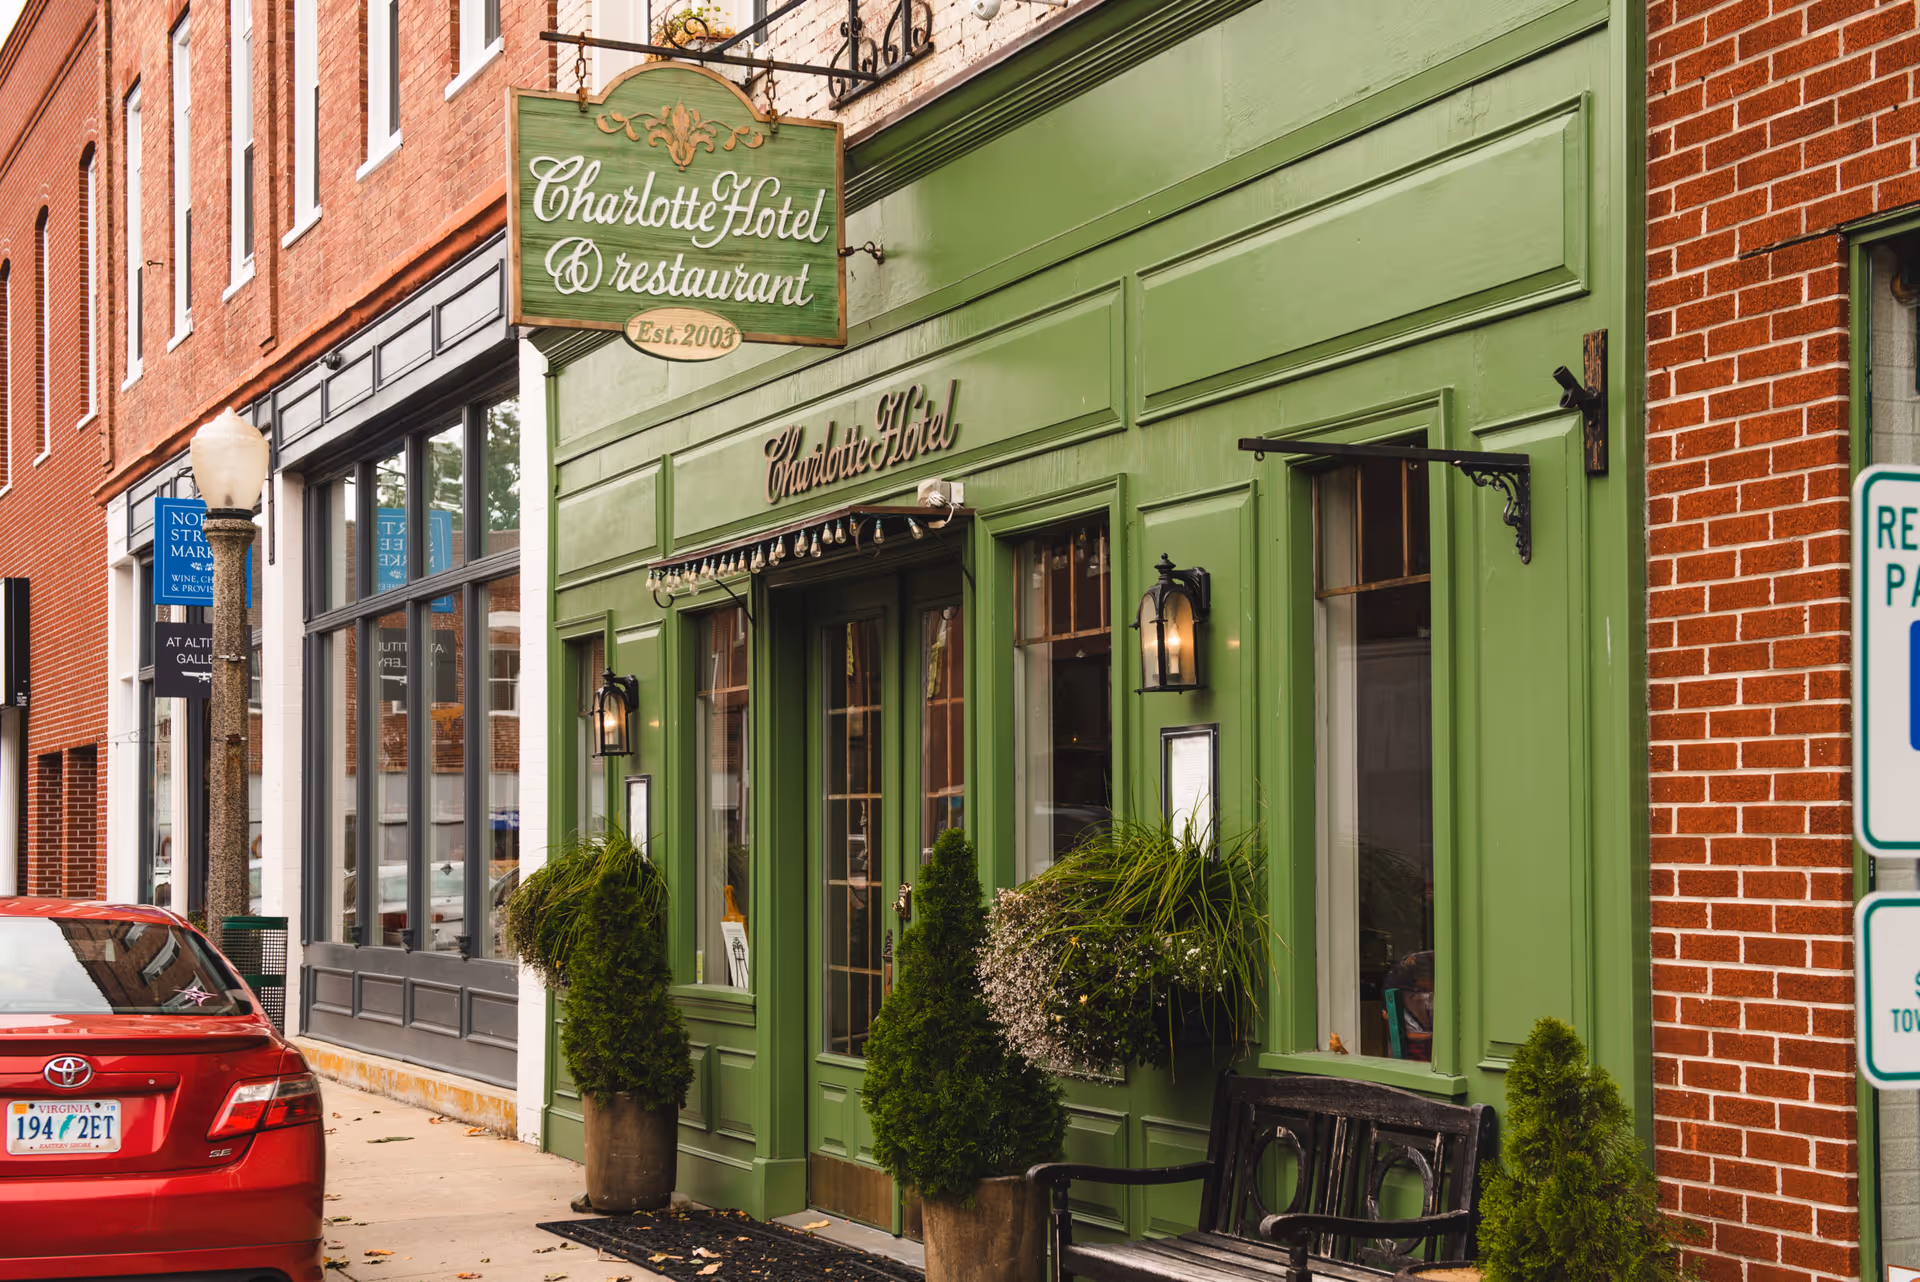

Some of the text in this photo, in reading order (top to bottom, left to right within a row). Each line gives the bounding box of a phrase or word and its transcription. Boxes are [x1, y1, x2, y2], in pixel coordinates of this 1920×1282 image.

[529, 155, 830, 249] Charlotte Hotel
[608, 252, 814, 306] restaurant
[764, 378, 960, 504] Charlotte Hotel
[171, 528, 209, 542] STR
[171, 583, 180, 592] &
[166, 636, 182, 648] AT
[39, 1104, 91, 1114] VIRGINIA
[17, 1115, 115, 1140] 194 2ET
[209, 1148, 232, 1158] SE
